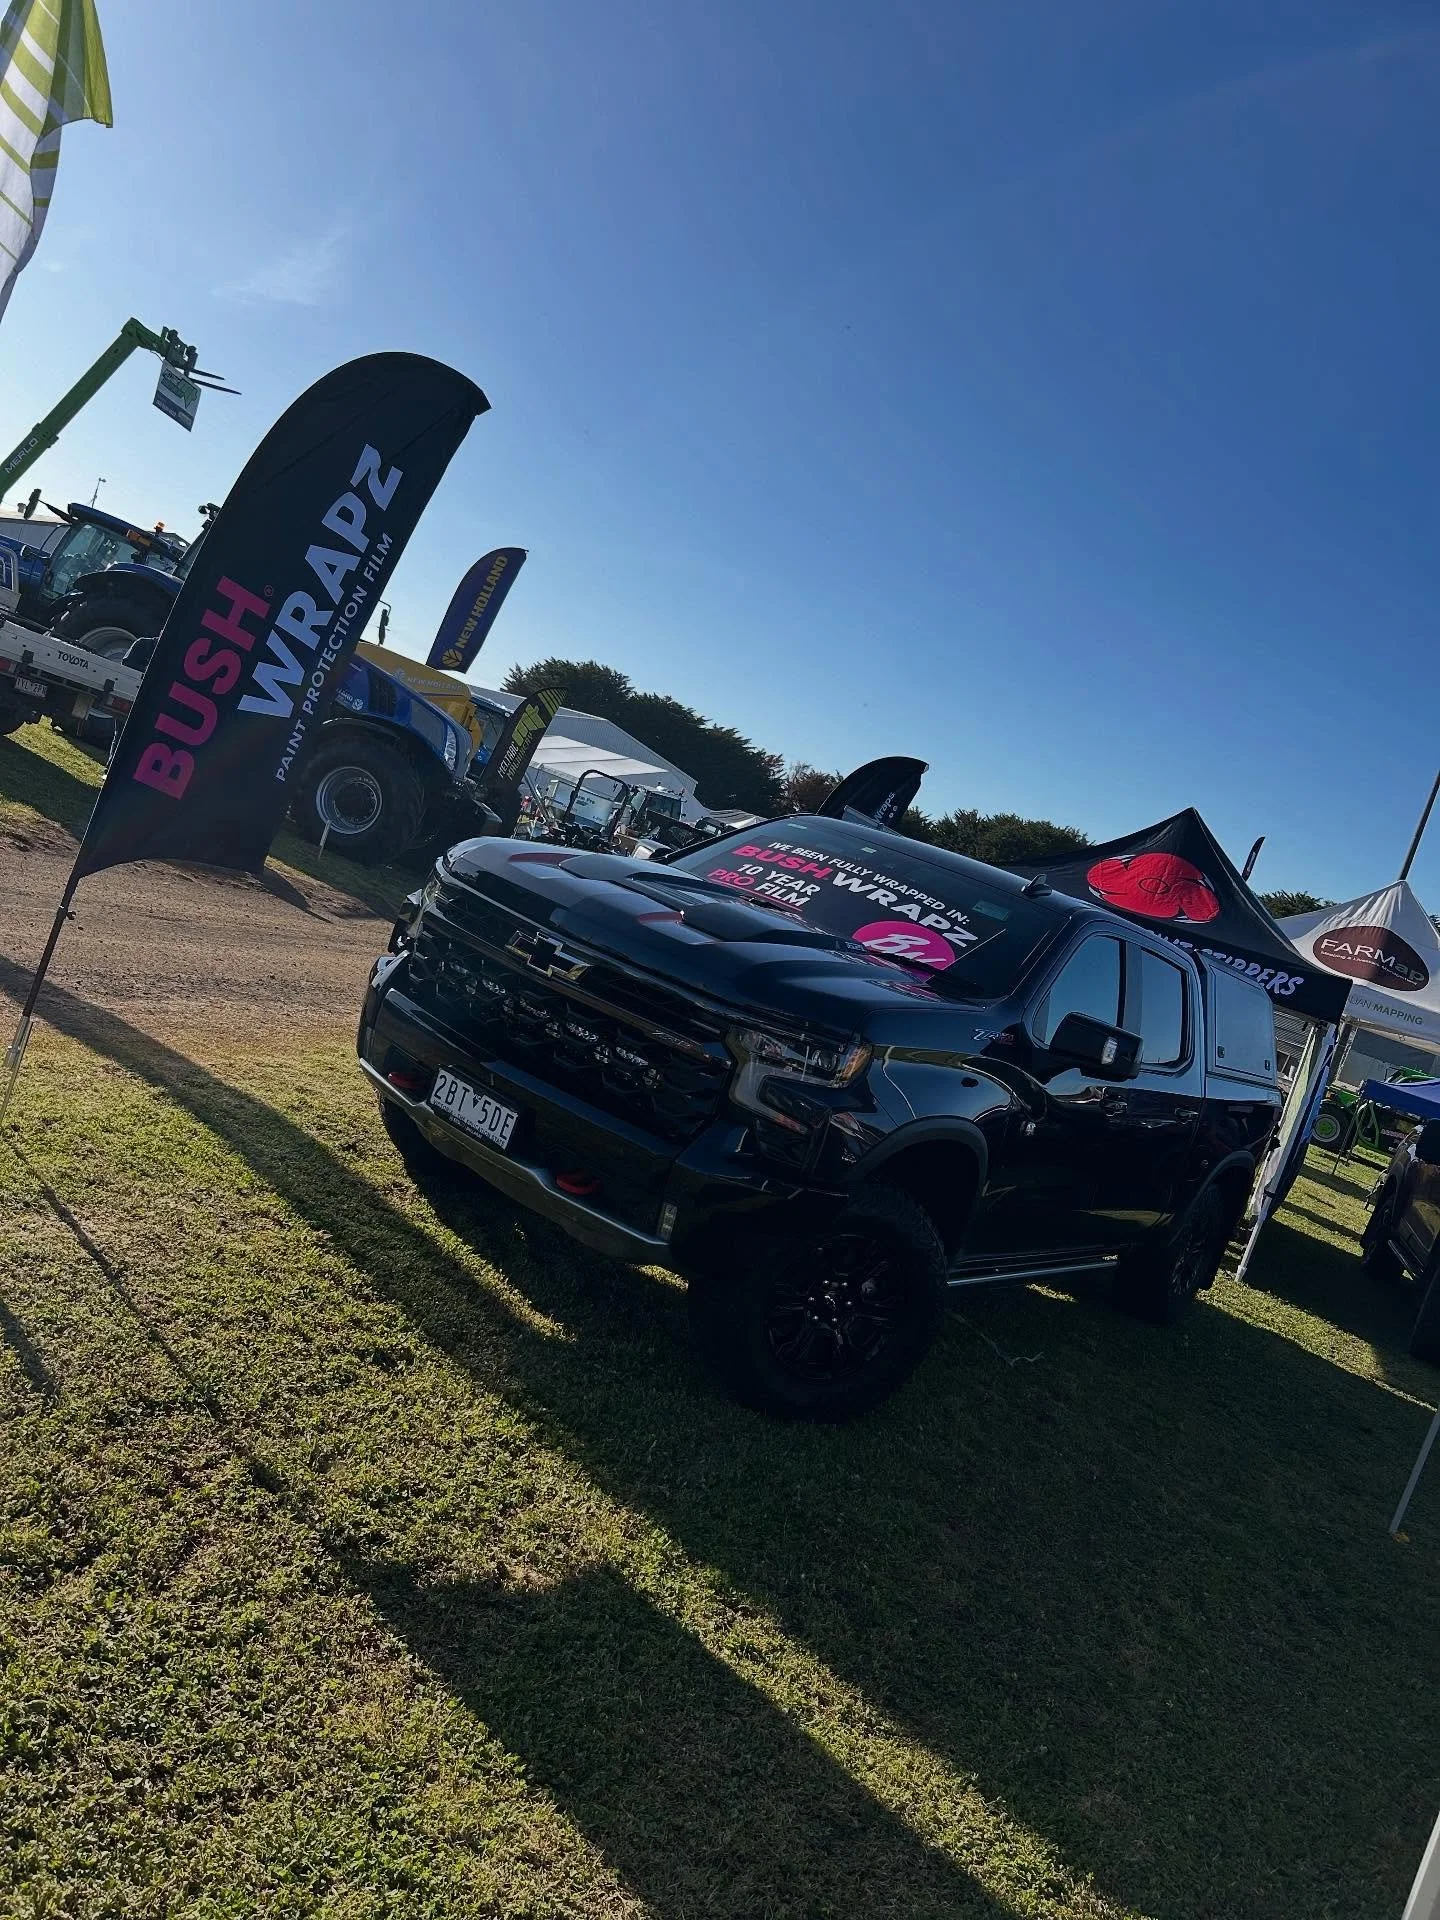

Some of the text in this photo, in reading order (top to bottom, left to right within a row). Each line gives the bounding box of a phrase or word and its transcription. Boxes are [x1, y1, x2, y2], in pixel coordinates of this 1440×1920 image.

[4, 437, 39, 474] MERLO
[133, 443, 403, 800] BUSH WRAPZ
[455, 555, 509, 649] NEW HOLLAND
[58, 651, 89, 669] TOYOTA
[275, 721, 307, 783] PAINT
[303, 584, 368, 716] PROTECTION
[363, 532, 393, 584] FILM
[706, 868, 811, 907] PRO FILM
[732, 845, 979, 948] BUSH WRAPZ
[737, 863, 821, 896] 10 YEAR
[791, 847, 830, 862] BEEN
[828, 858, 873, 876] FULLY
[872, 873, 946, 910] WRAPPED
[946, 909, 971, 925] IN:
[1320, 938, 1425, 981] FARMap
[1373, 1003, 1423, 1026] MAPPING
[433, 1074, 471, 1112] 2BT
[477, 1099, 515, 1141] 5DE
